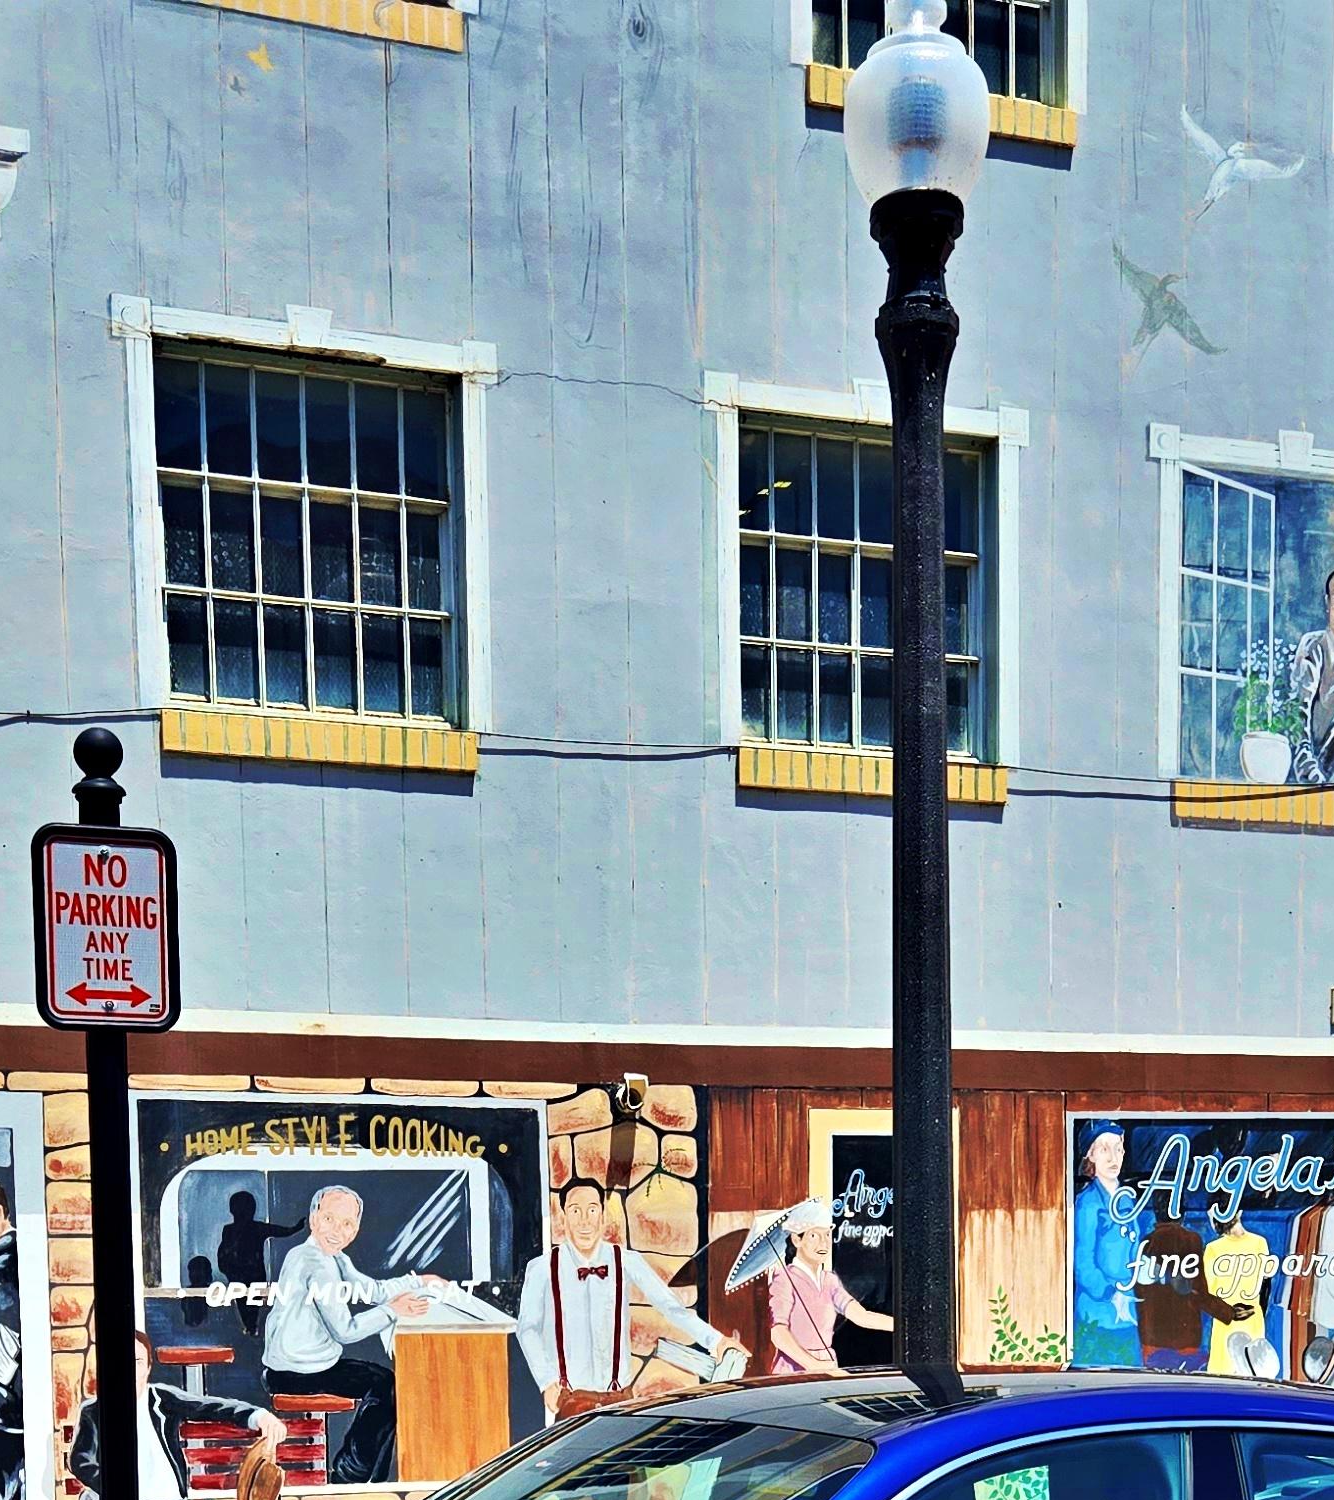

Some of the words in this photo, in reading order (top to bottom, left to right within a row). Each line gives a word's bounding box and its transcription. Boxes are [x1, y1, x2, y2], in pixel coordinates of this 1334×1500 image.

[84, 854, 128, 888] NO
[55, 892, 158, 930] PARKING
[85, 931, 130, 954] ANY
[82, 957, 134, 982] TIME
[185, 1122, 255, 1158] HOME
[265, 1113, 358, 1157] STYLE
[369, 1114, 486, 1160] COOKING
[205, 1280, 289, 1307] OPEN
